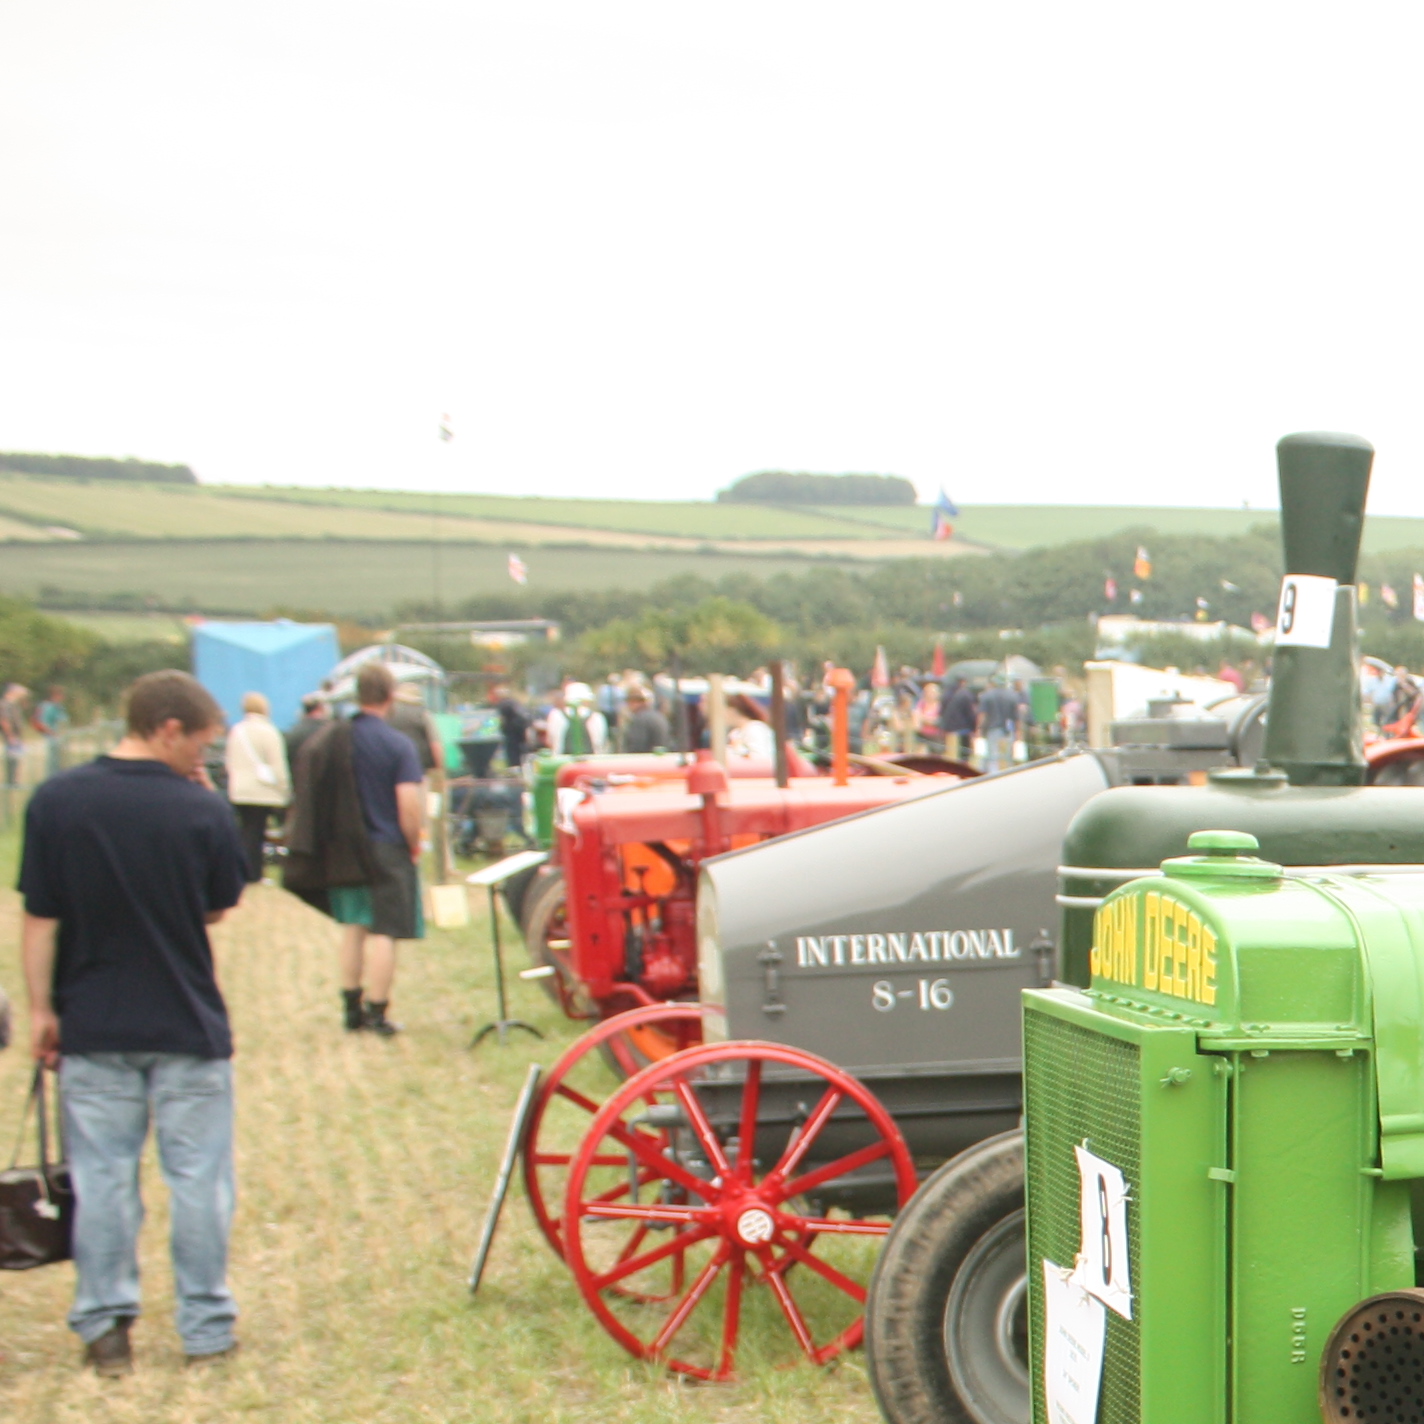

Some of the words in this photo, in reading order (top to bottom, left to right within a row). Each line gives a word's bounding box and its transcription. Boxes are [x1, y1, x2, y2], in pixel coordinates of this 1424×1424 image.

[1282, 583, 1297, 634] 9
[796, 929, 1021, 967] INTERNATIONAL
[1091, 892, 1138, 985] JOHN
[1144, 891, 1218, 1005] DEERE
[872, 978, 955, 1012] 8-16
[1098, 1173, 1112, 1286] 8
